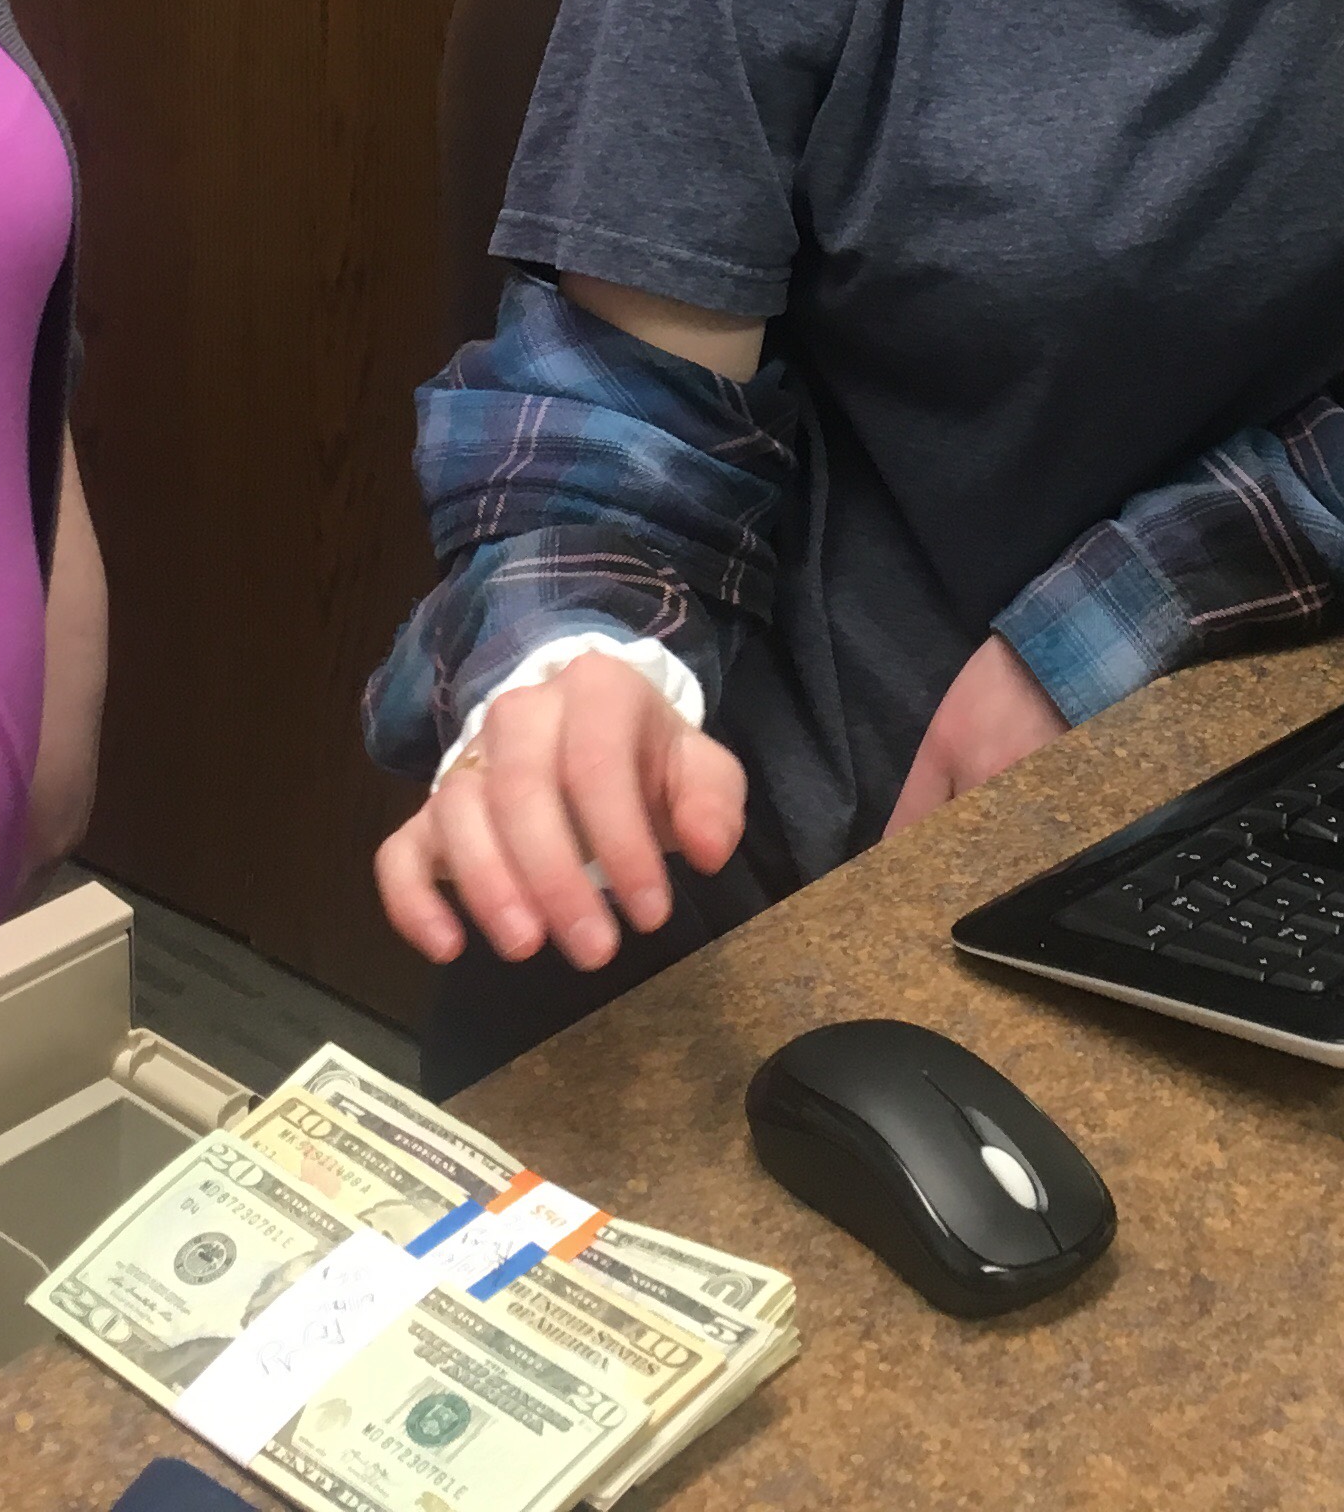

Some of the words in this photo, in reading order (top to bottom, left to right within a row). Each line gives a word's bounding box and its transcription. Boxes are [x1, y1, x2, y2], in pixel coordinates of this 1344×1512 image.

[283, 1102, 334, 1142] 10
[199, 1140, 265, 1190] 20
[47, 1277, 137, 1347] 20
[699, 1312, 746, 1347] 5
[632, 1327, 691, 1370] 10
[567, 1383, 627, 1430] 20
